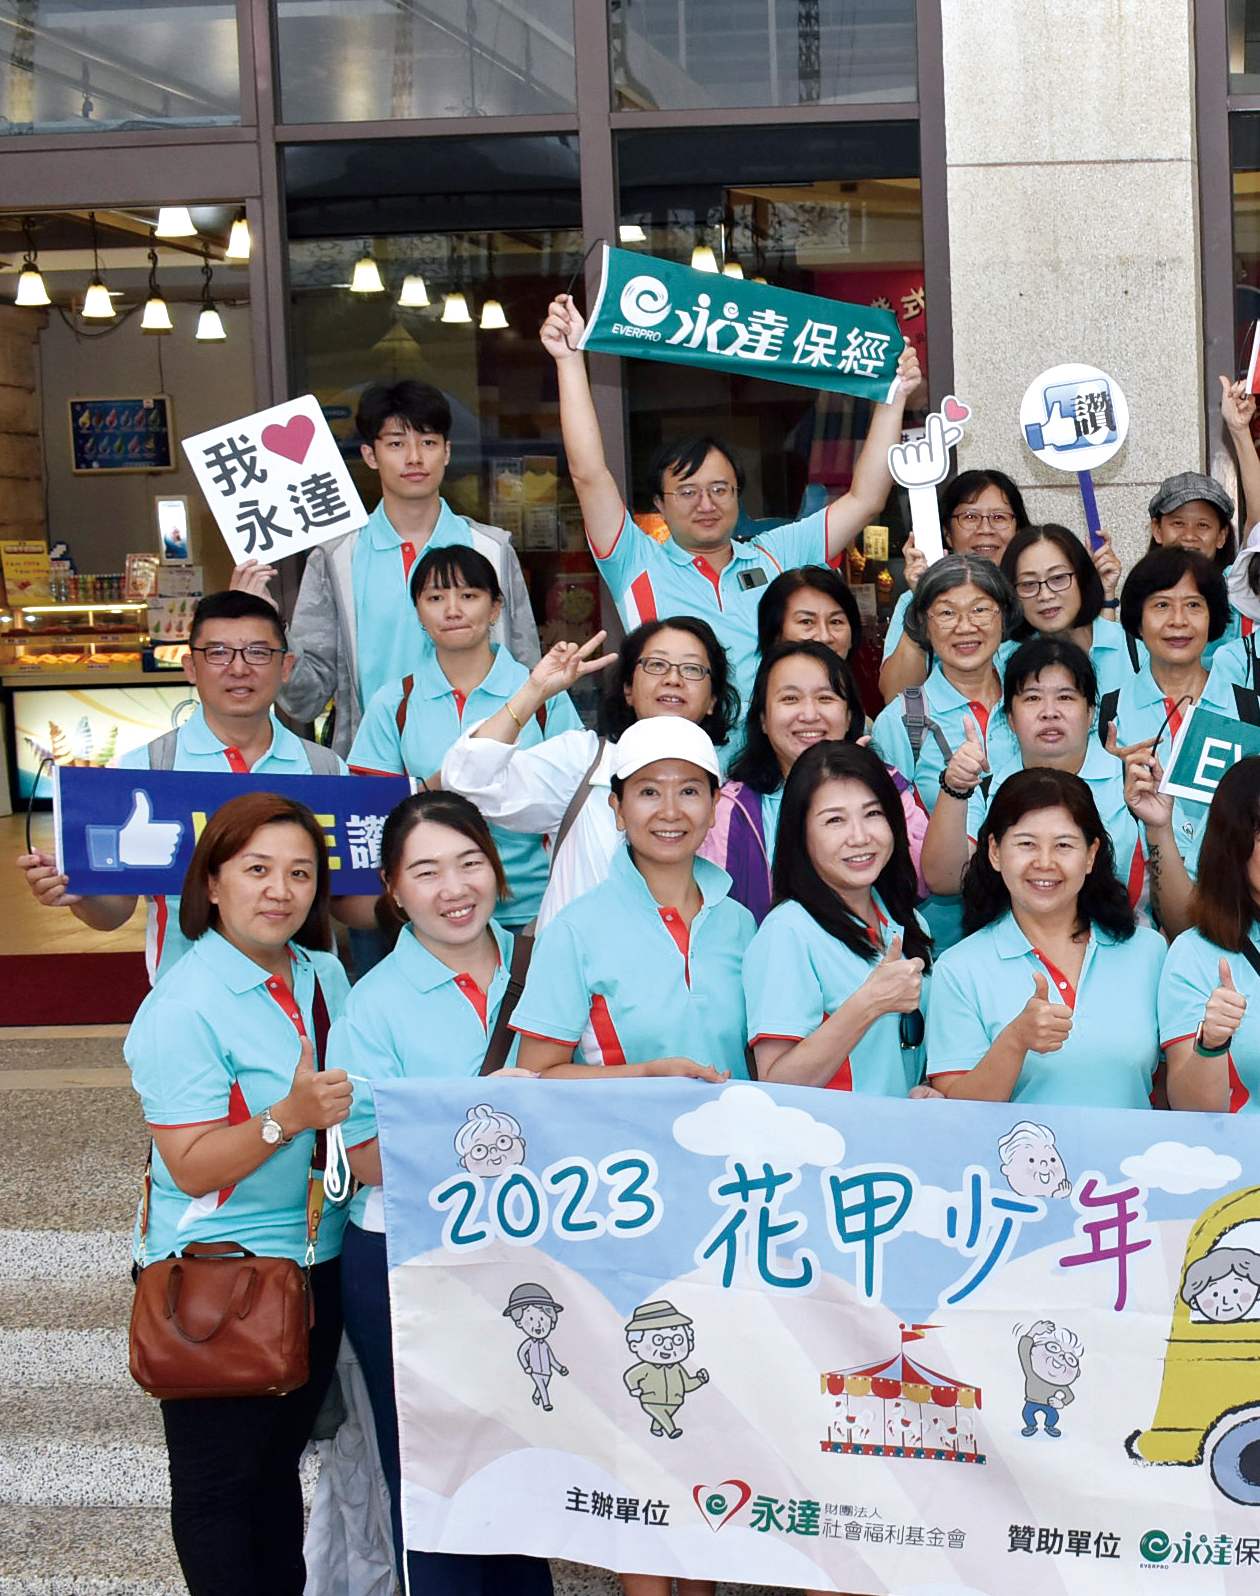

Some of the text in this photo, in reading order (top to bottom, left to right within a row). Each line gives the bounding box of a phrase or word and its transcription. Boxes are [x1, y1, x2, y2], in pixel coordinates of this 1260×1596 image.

[611, 322, 662, 342] EVERPRO
[665, 293, 891, 379] 永達保經
[1070, 391, 1117, 437] 讚
[202, 433, 268, 497] 我
[235, 471, 351, 554] 永達
[438, 1158, 655, 1245] 2023
[703, 1162, 1152, 1312] 花甲少年
[565, 1486, 670, 1527] 主辦單位
[749, 1494, 821, 1537] 永達
[824, 1502, 884, 1520] 財團法人
[822, 1517, 968, 1549] 社會福利基金會
[1139, 1563, 1170, 1571] EVERPRO
